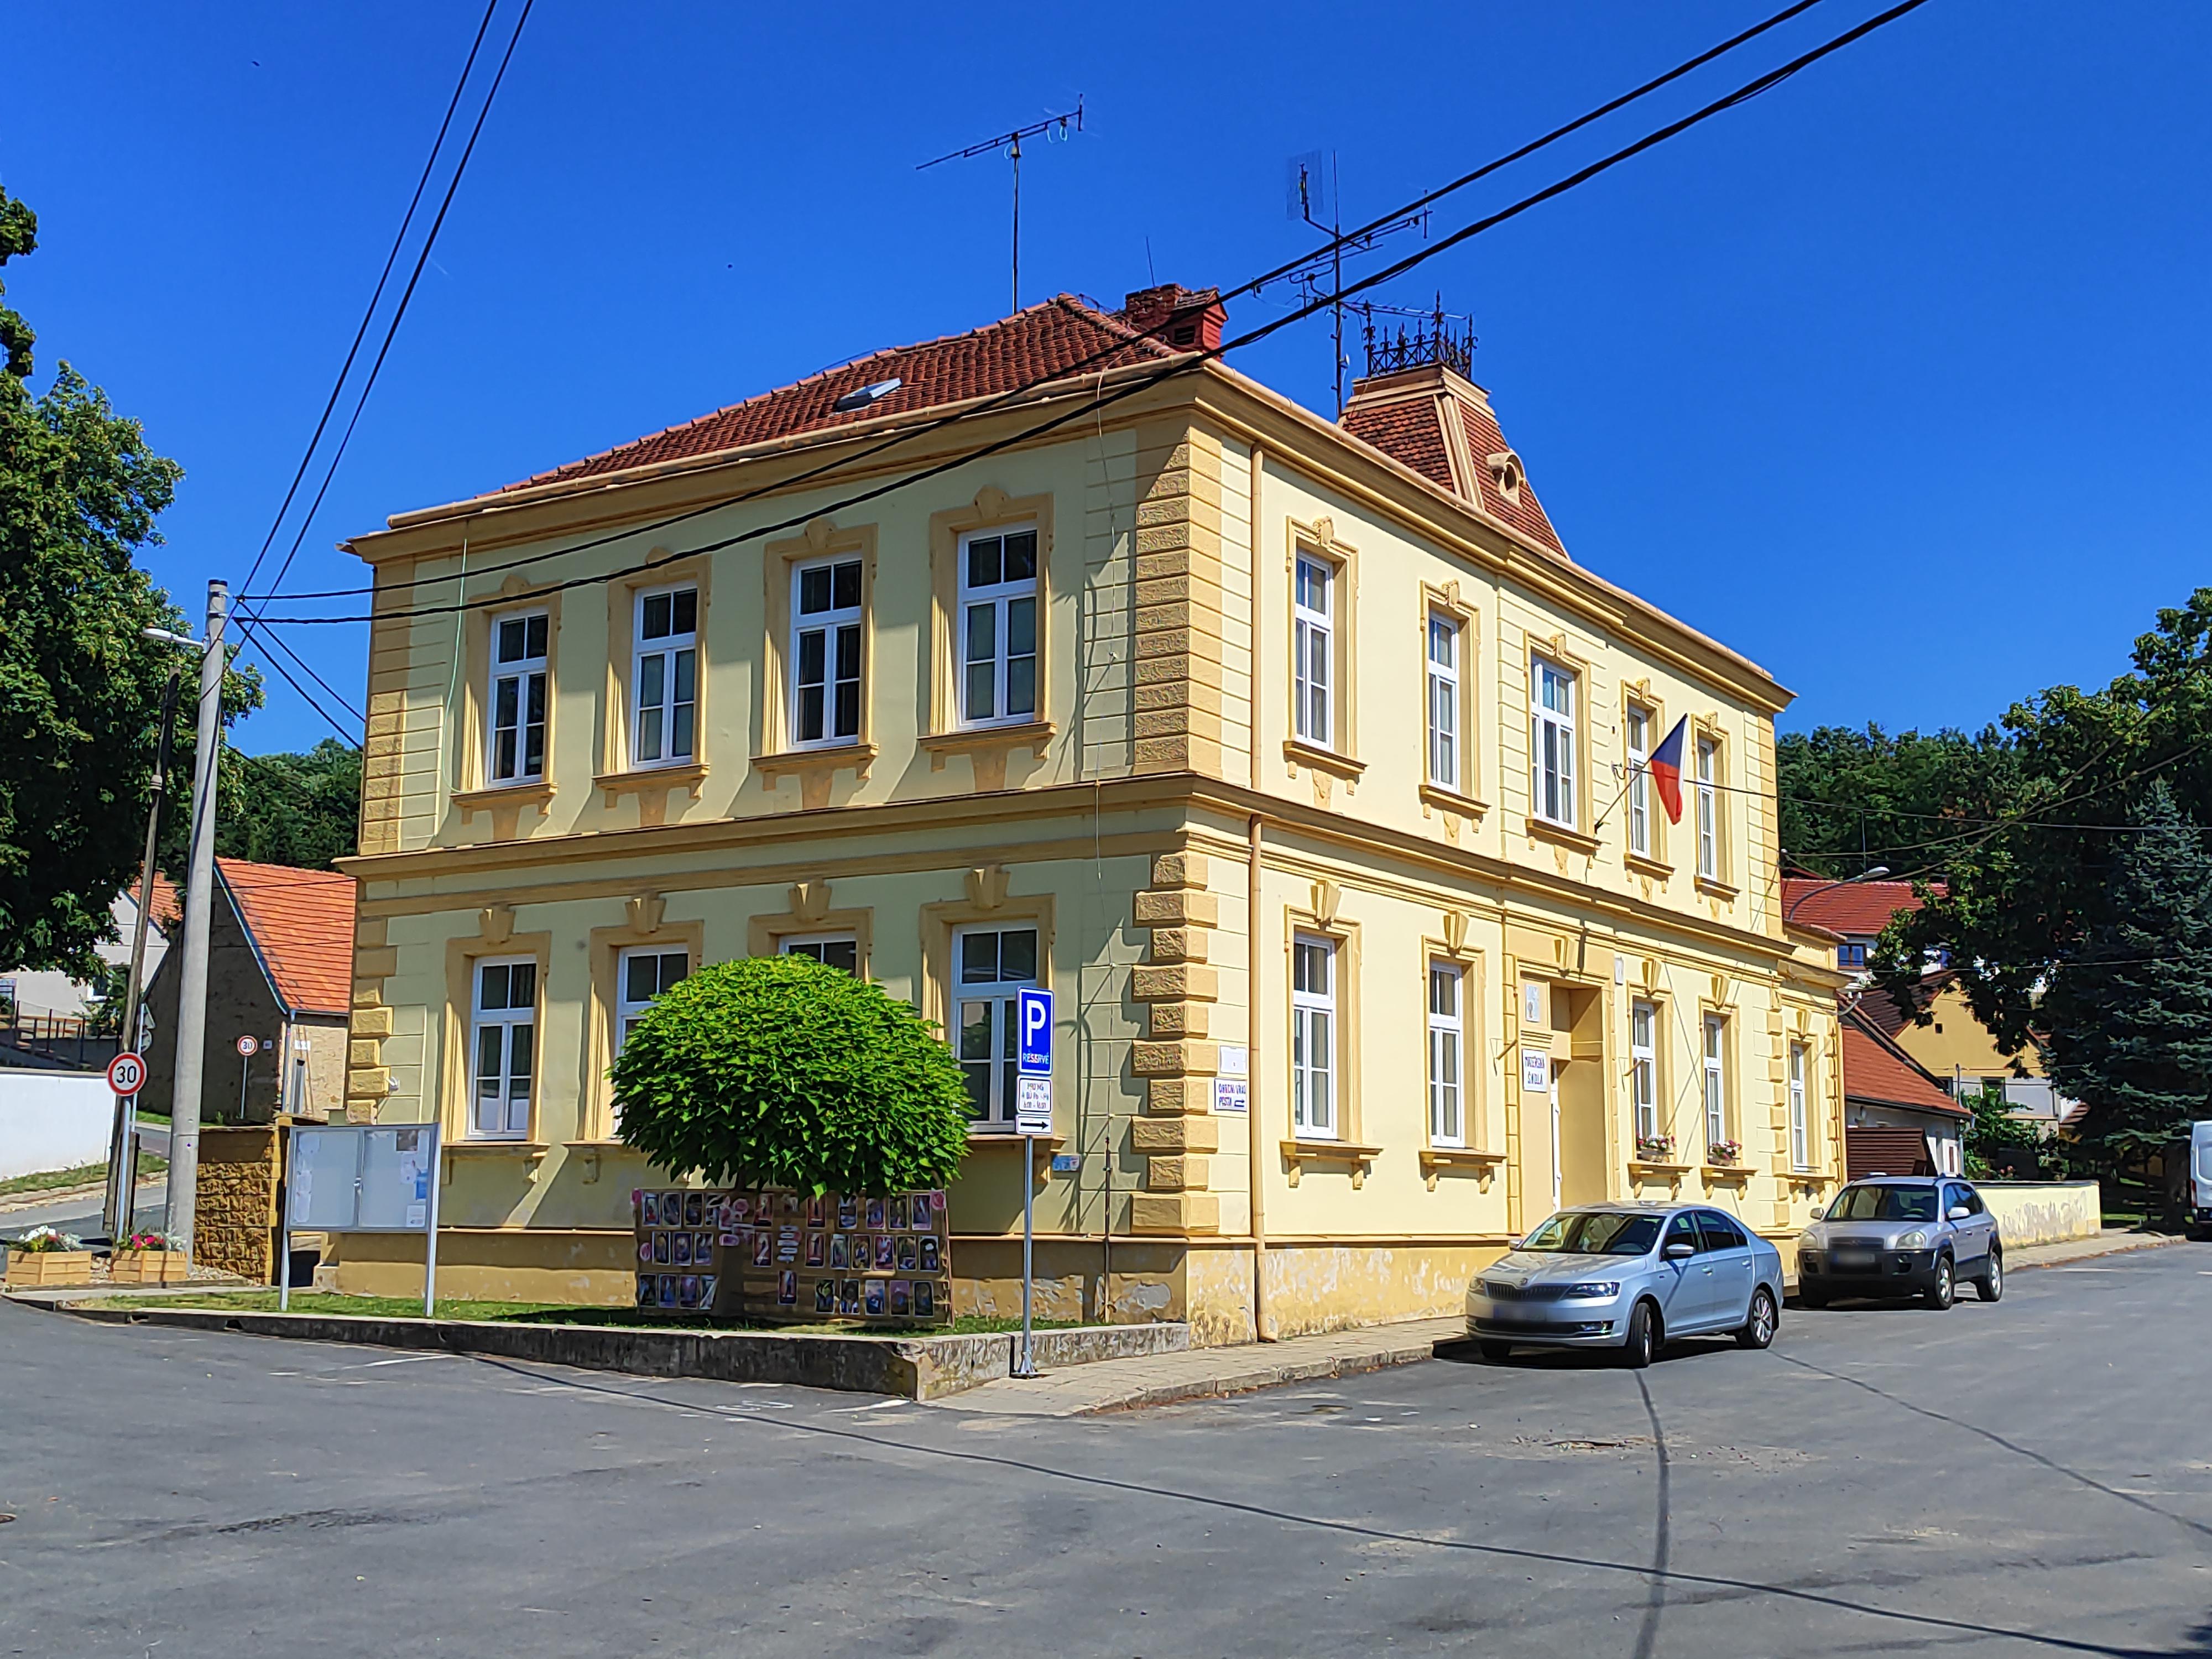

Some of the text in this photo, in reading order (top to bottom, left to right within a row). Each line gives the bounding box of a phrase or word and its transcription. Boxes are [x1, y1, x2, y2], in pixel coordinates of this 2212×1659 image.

[1026, 999, 1046, 1047] P
[243, 1041, 253, 1050] 30
[116, 1065, 137, 1083] 30
